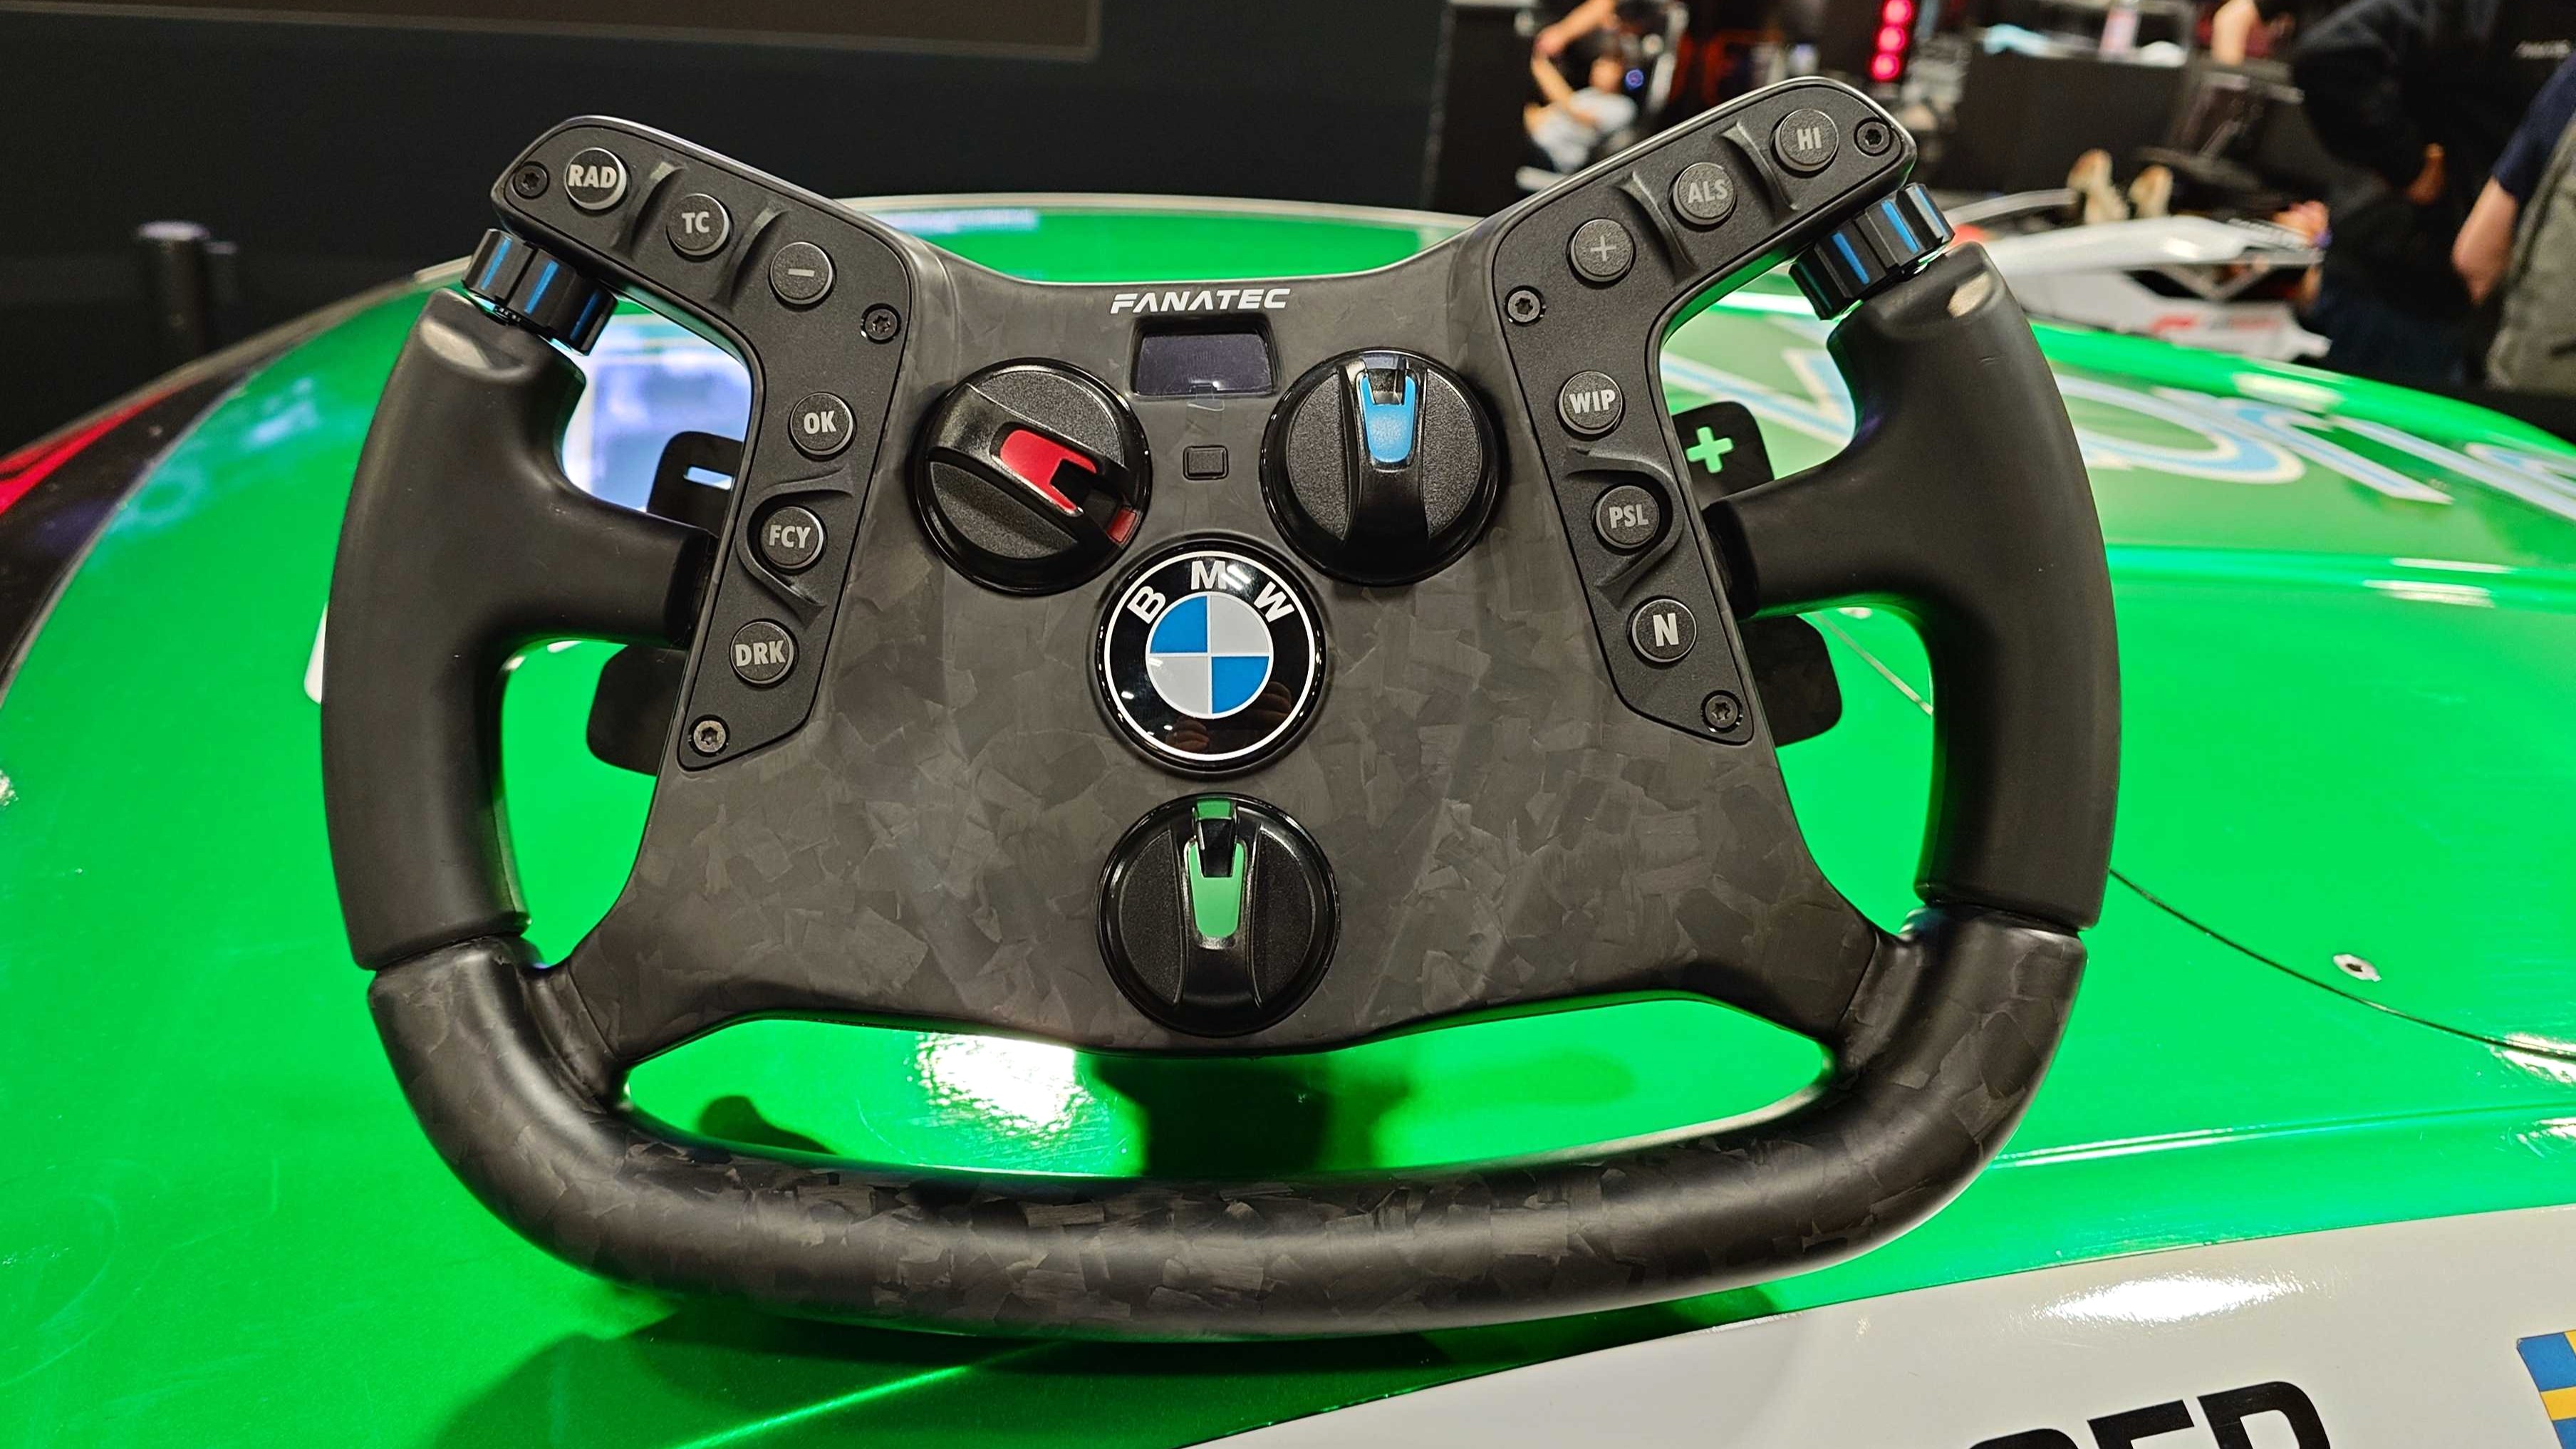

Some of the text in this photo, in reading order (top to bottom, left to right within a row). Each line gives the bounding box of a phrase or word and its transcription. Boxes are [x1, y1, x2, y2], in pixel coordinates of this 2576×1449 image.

[1796, 127, 1821, 150] HI
[568, 165, 617, 189] RAD
[1688, 179, 1728, 204] ALS
[682, 211, 710, 234] TC
[1110, 288, 1291, 314] FANATEC
[1569, 389, 1616, 414] WIP
[804, 410, 837, 434] OK
[1609, 504, 1649, 529] PSL
[769, 524, 811, 549] FCY
[1126, 559, 1295, 625] BMW
[1653, 613, 1680, 647] N
[735, 640, 786, 667] DRK
